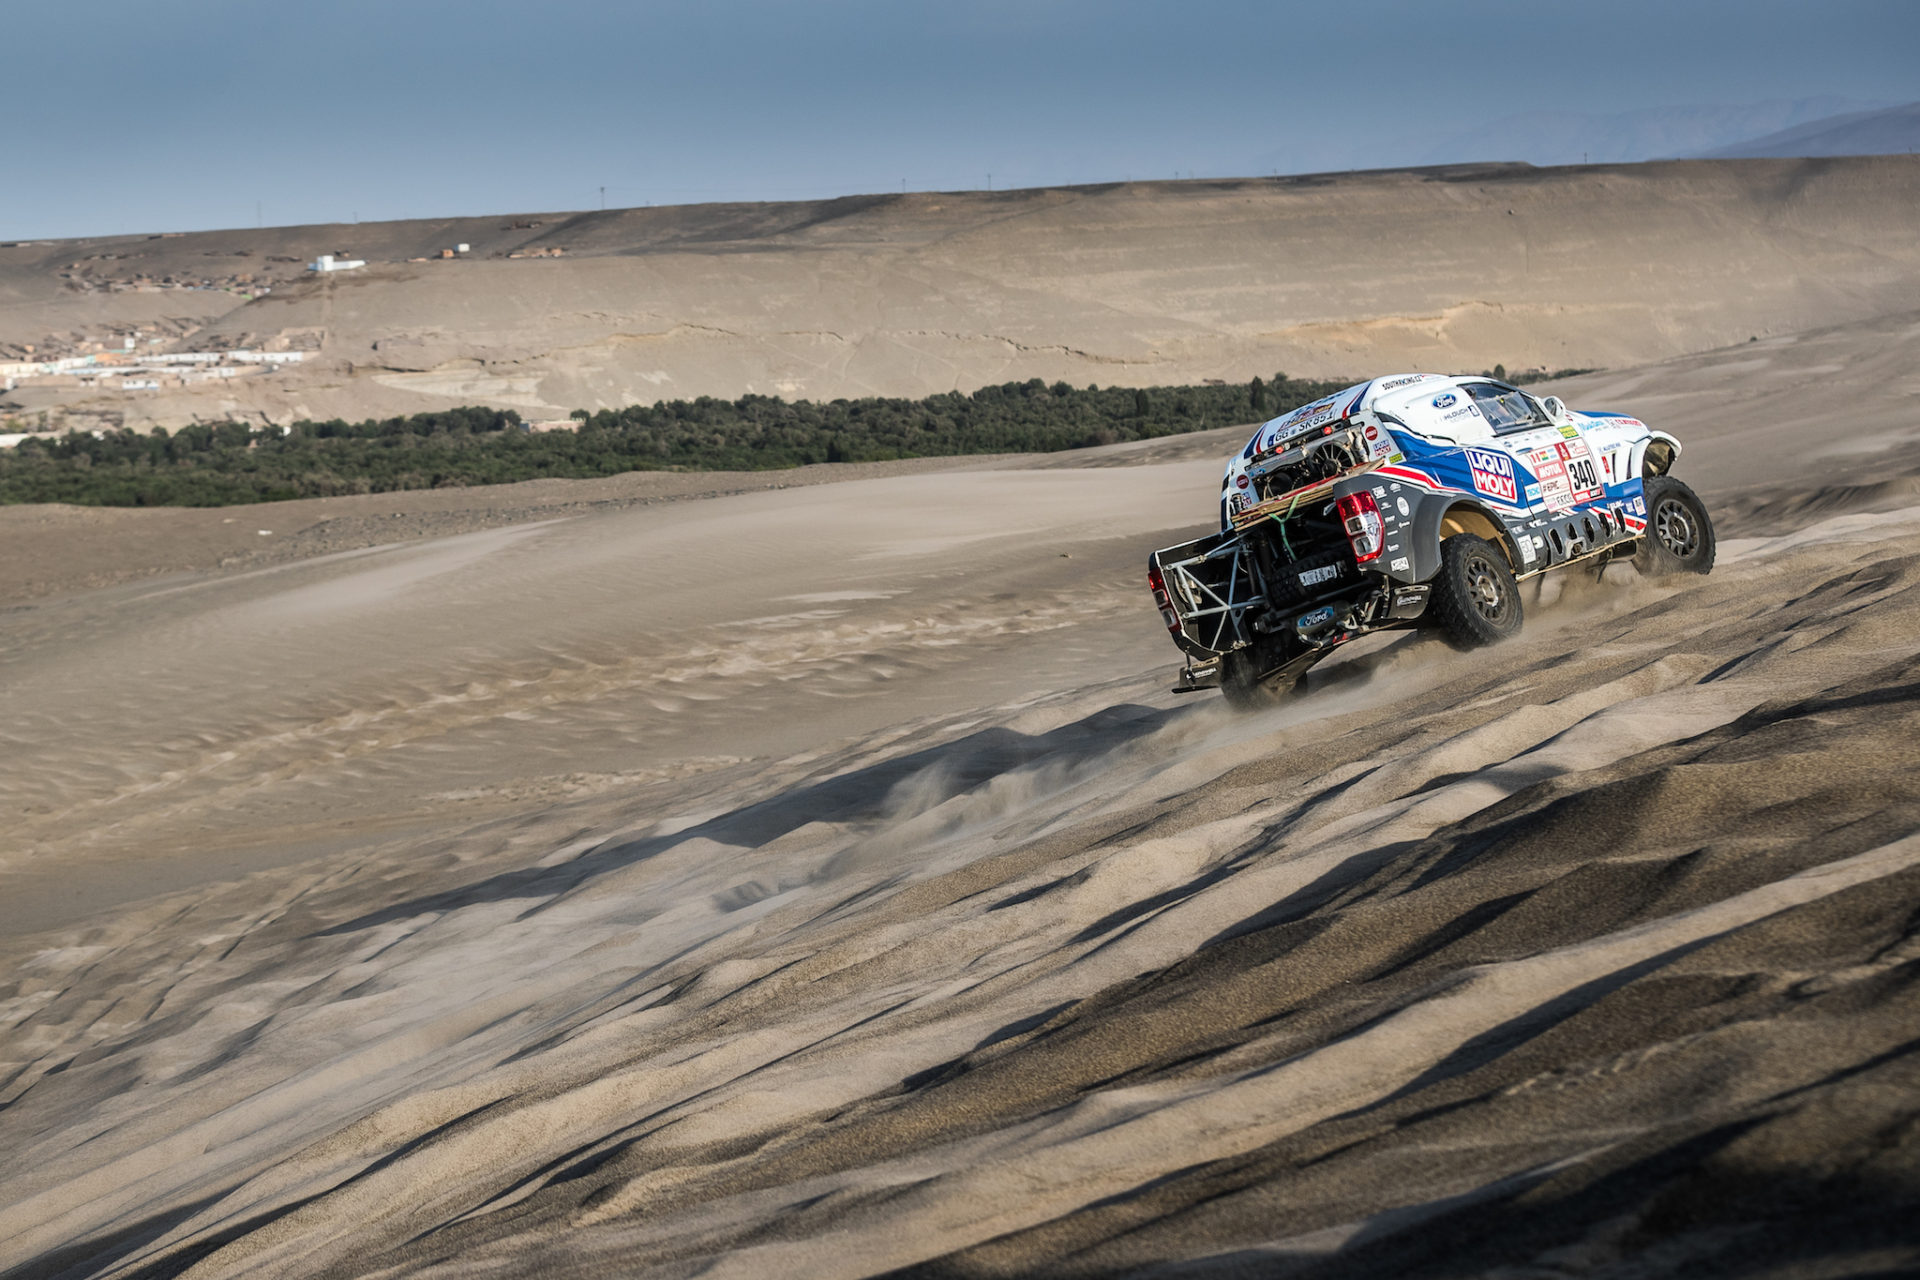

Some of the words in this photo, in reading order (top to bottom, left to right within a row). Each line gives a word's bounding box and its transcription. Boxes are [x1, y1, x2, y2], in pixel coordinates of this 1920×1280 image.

[1275, 430, 1289, 442] GG
[1467, 451, 1511, 478] LIQUI
[1538, 463, 1563, 480] MOTUL
[1569, 459, 1597, 491] 340
[1474, 470, 1513, 498] MOLY
[1305, 609, 1329, 626] Ford
